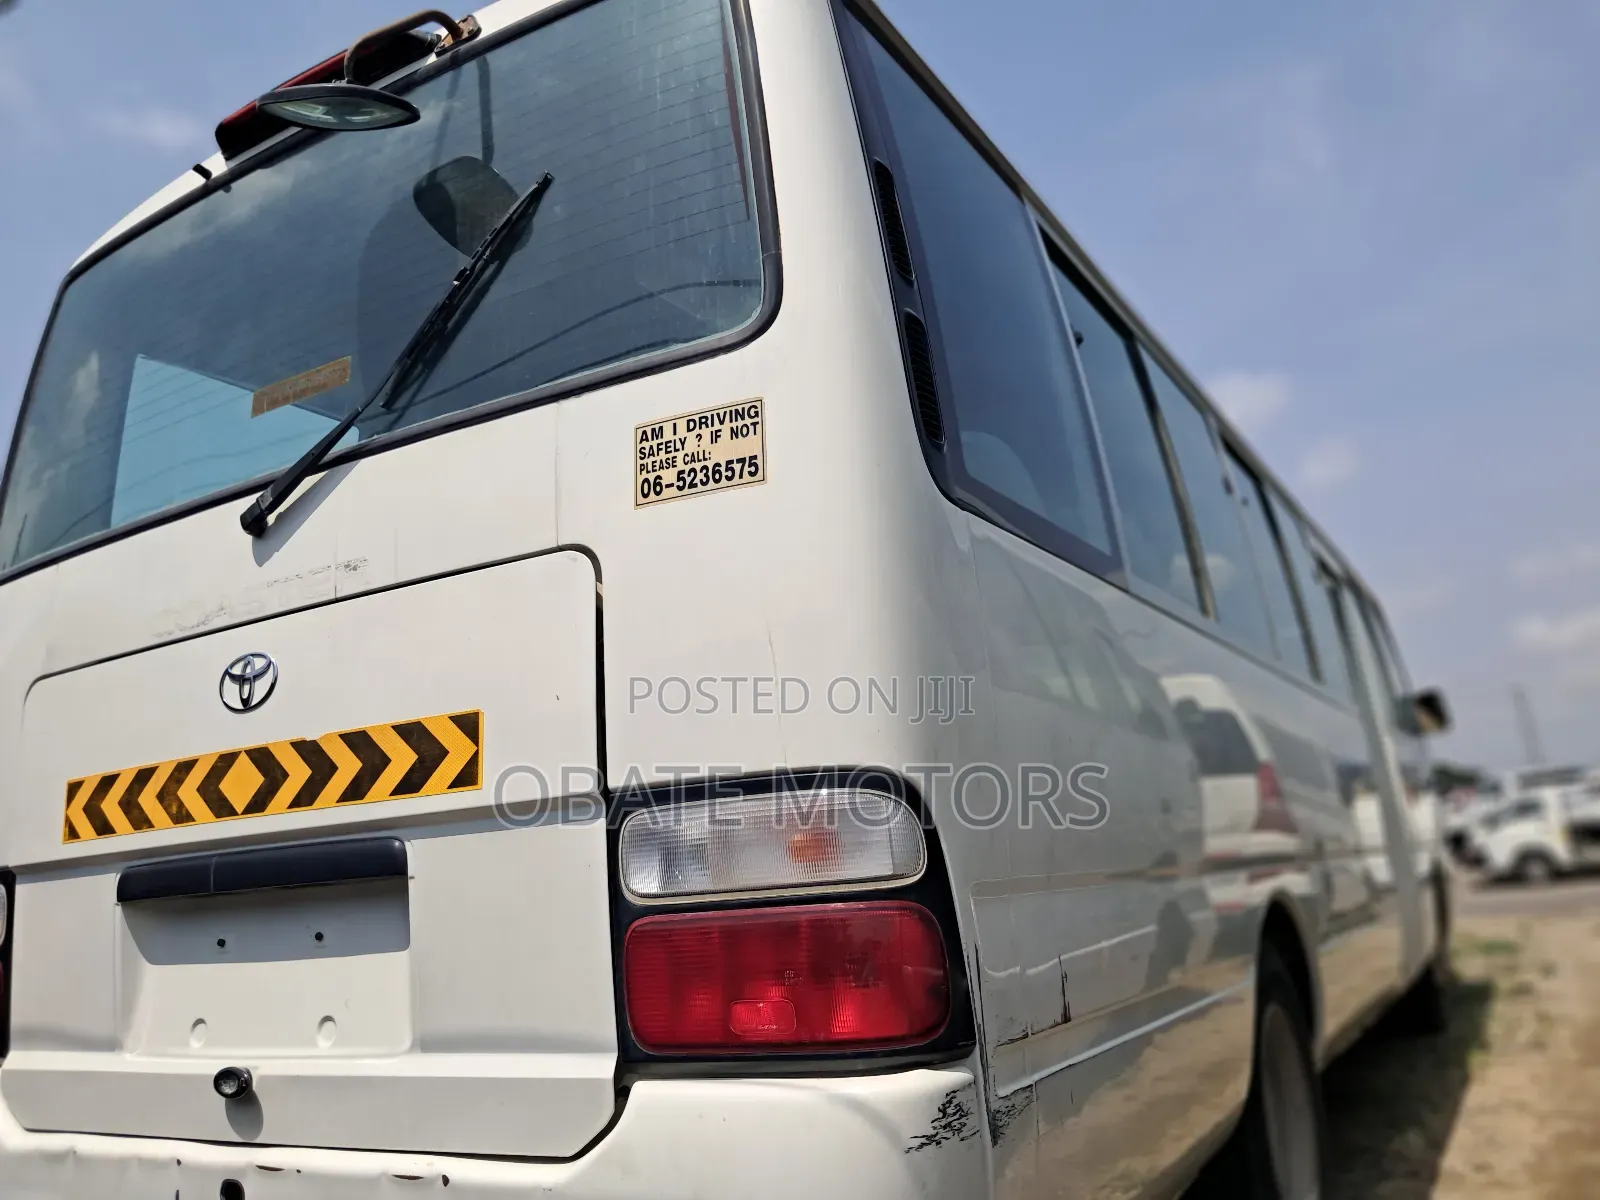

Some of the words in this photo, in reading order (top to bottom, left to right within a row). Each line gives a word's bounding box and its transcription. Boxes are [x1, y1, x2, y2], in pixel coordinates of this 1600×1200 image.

[638, 436, 687, 461] SAFELY
[710, 429, 722, 444] IF
[730, 421, 760, 440] NOT
[639, 425, 664, 445] AM
[672, 422, 677, 436] I
[686, 404, 760, 433] DRIVING
[639, 455, 678, 475] PLEASE
[682, 449, 712, 466] CALL:
[640, 454, 760, 499] 06-5236575
